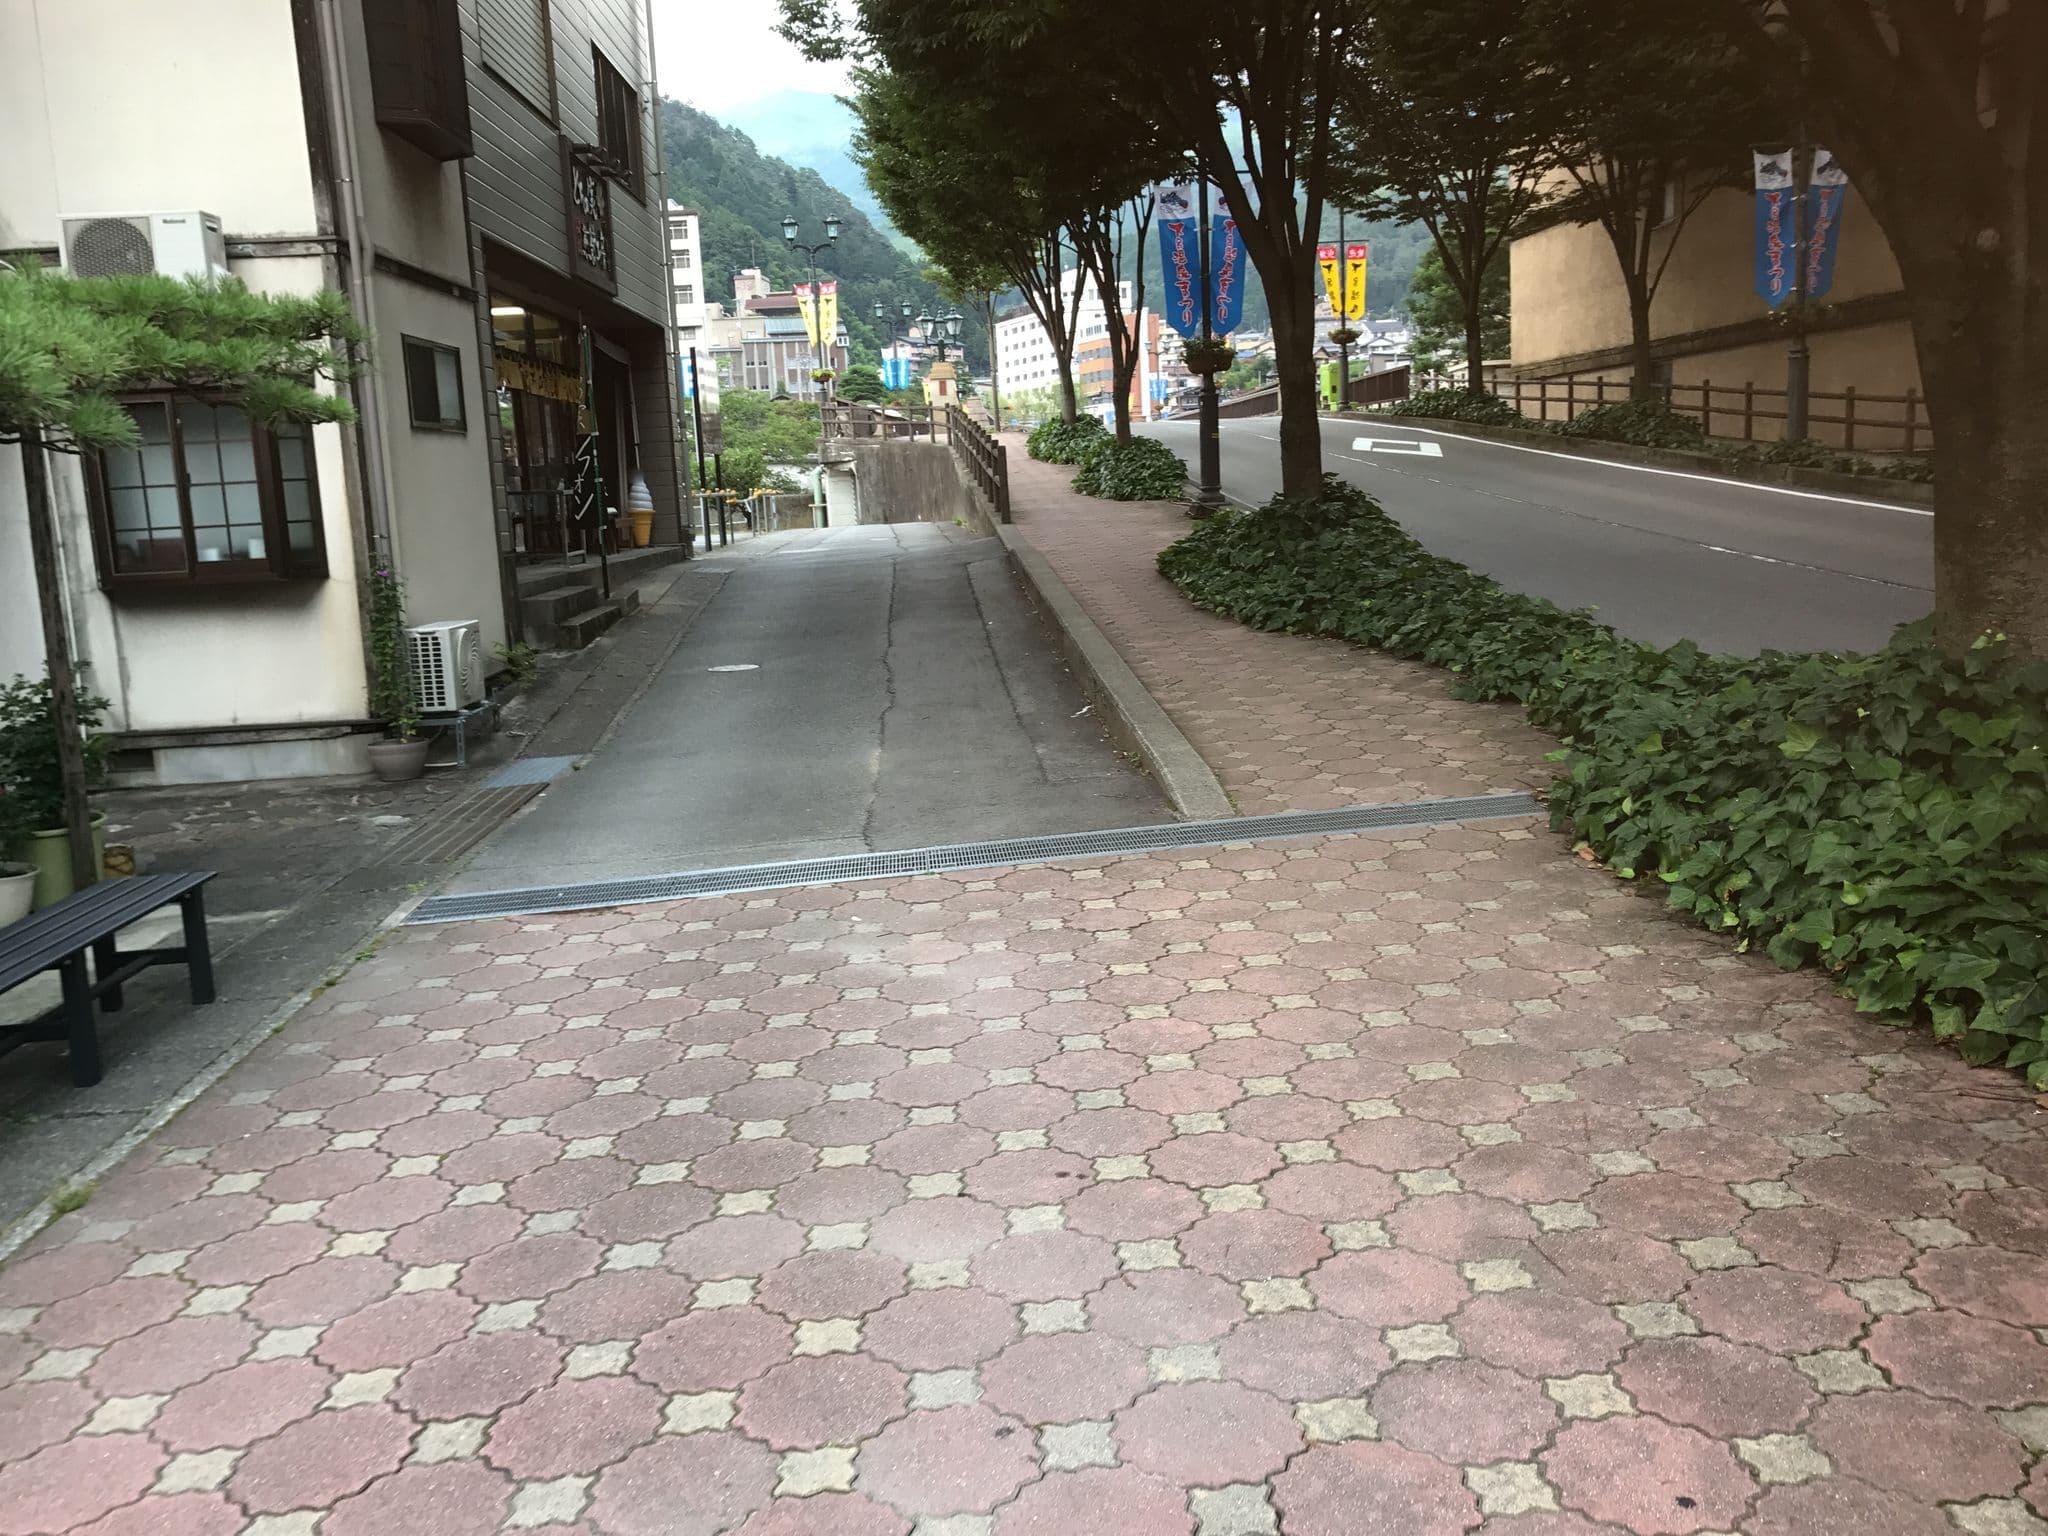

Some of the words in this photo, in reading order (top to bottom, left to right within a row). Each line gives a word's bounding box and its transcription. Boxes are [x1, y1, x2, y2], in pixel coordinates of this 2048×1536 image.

[1167, 221, 1194, 327] 下呂温泉まつり
